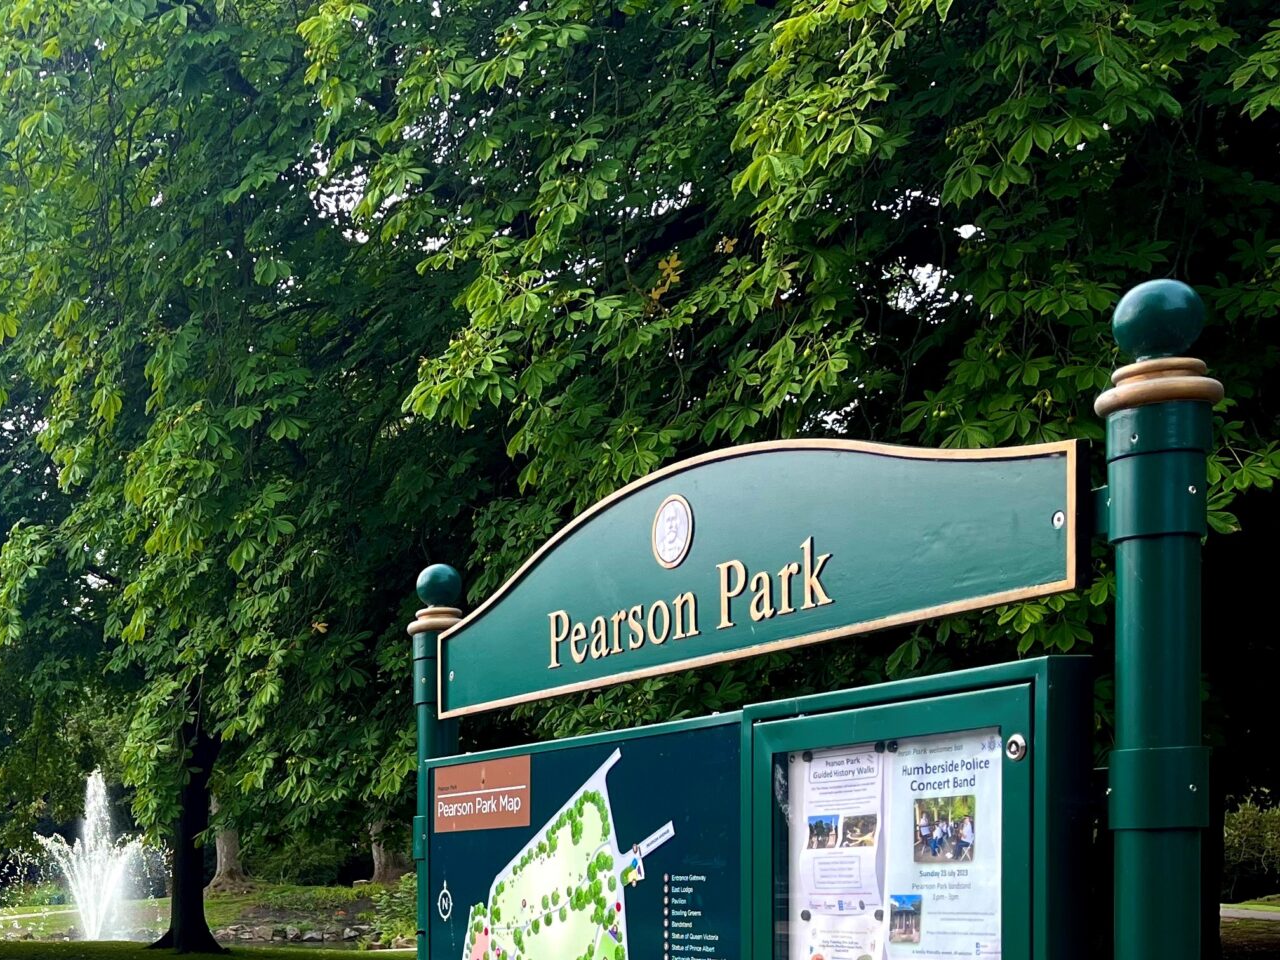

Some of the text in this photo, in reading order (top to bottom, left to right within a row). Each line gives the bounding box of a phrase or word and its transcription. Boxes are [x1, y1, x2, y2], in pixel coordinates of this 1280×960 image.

[548, 536, 835, 669] Pearson Park
[846, 756, 860, 764] Park
[902, 758, 990, 776] Humberside Police
[813, 766, 874, 778] Guided History Walks
[910, 775, 976, 791] Concert Band
[438, 795, 521, 818] Pearson Park Map
[442, 897, 449, 910] N
